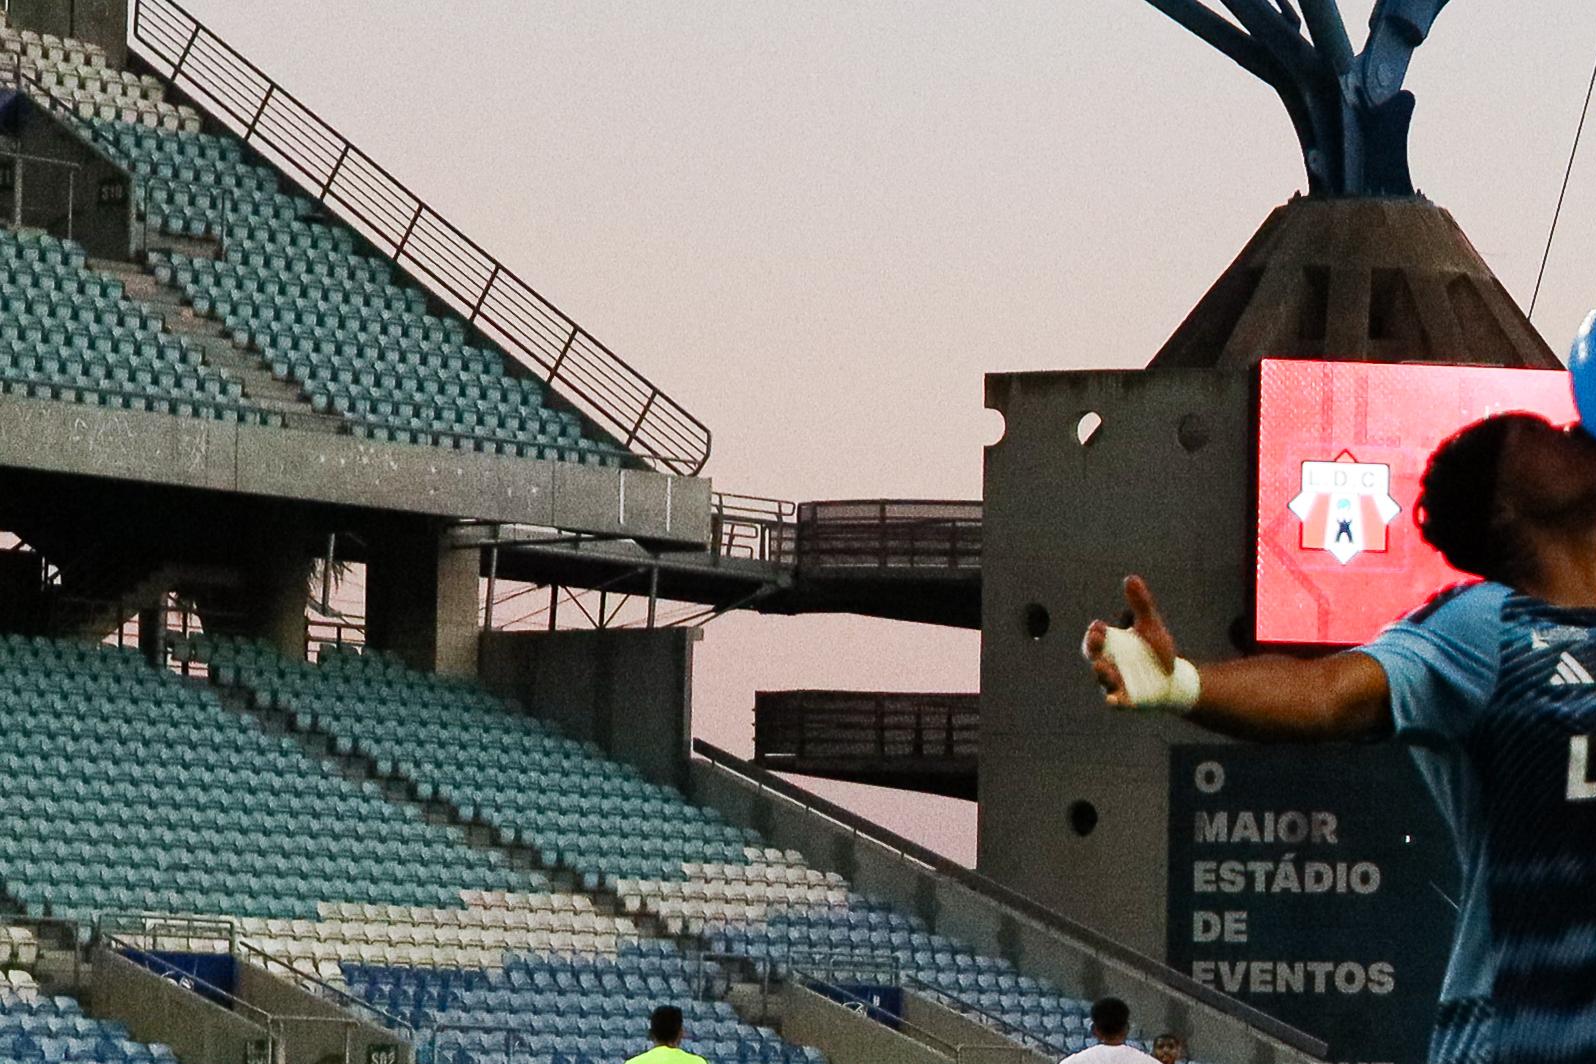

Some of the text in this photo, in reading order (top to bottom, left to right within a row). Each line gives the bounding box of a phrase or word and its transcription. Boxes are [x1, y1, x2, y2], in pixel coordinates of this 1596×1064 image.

[1194, 760, 1225, 793] O
[1193, 811, 1338, 845] MAIOR
[1193, 853, 1381, 894] ESTÁDIO
[1193, 911, 1248, 943] DE
[1192, 961, 1395, 995] EVENTOS
